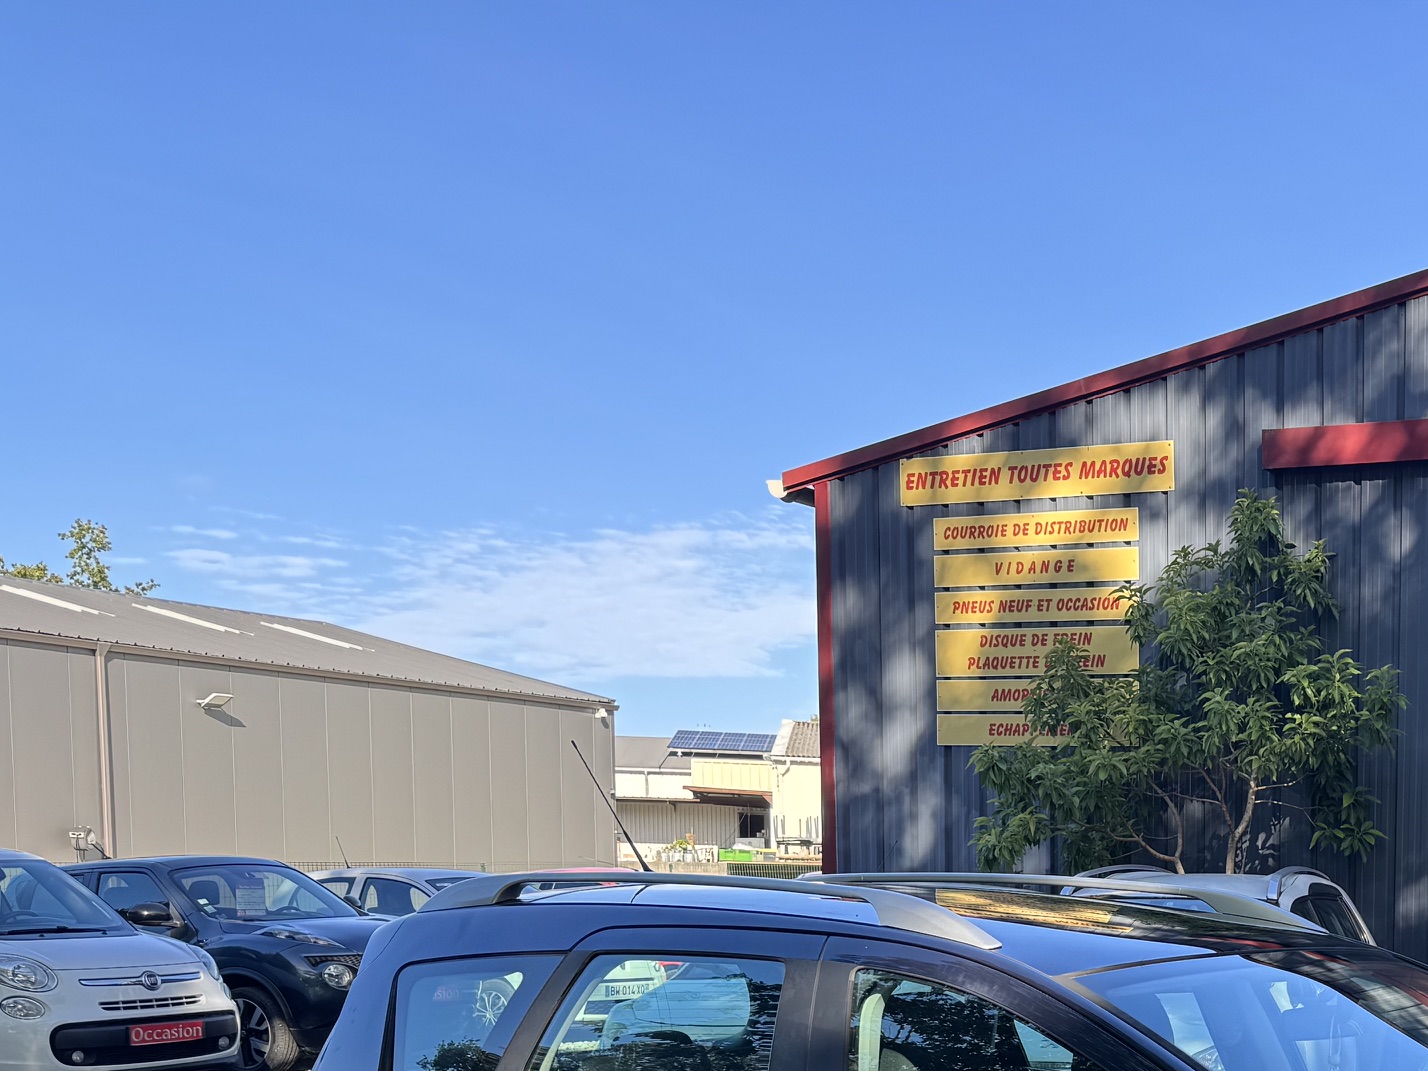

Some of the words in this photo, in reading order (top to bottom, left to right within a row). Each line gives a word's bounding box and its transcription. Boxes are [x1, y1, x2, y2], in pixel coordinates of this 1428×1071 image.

[905, 466, 1002, 491] ENTRETIEN
[1007, 461, 1073, 484] TOUTES
[1078, 455, 1169, 480] MARQUES
[943, 523, 1008, 540] COURROIE
[1012, 522, 1031, 537] DE
[1034, 517, 1129, 536] DISTRIBUTION
[994, 558, 1076, 576] VIDANGE
[952, 600, 995, 615] PNEUS
[998, 599, 1033, 614] NEUF
[1036, 598, 1053, 613] ET
[1056, 597, 1121, 612] OCCASION
[979, 634, 1027, 649] DISQUE
[1031, 633, 1048, 647] DE
[967, 655, 1040, 670] PLAQUETTE
[131, 1024, 203, 1042] Occasion
